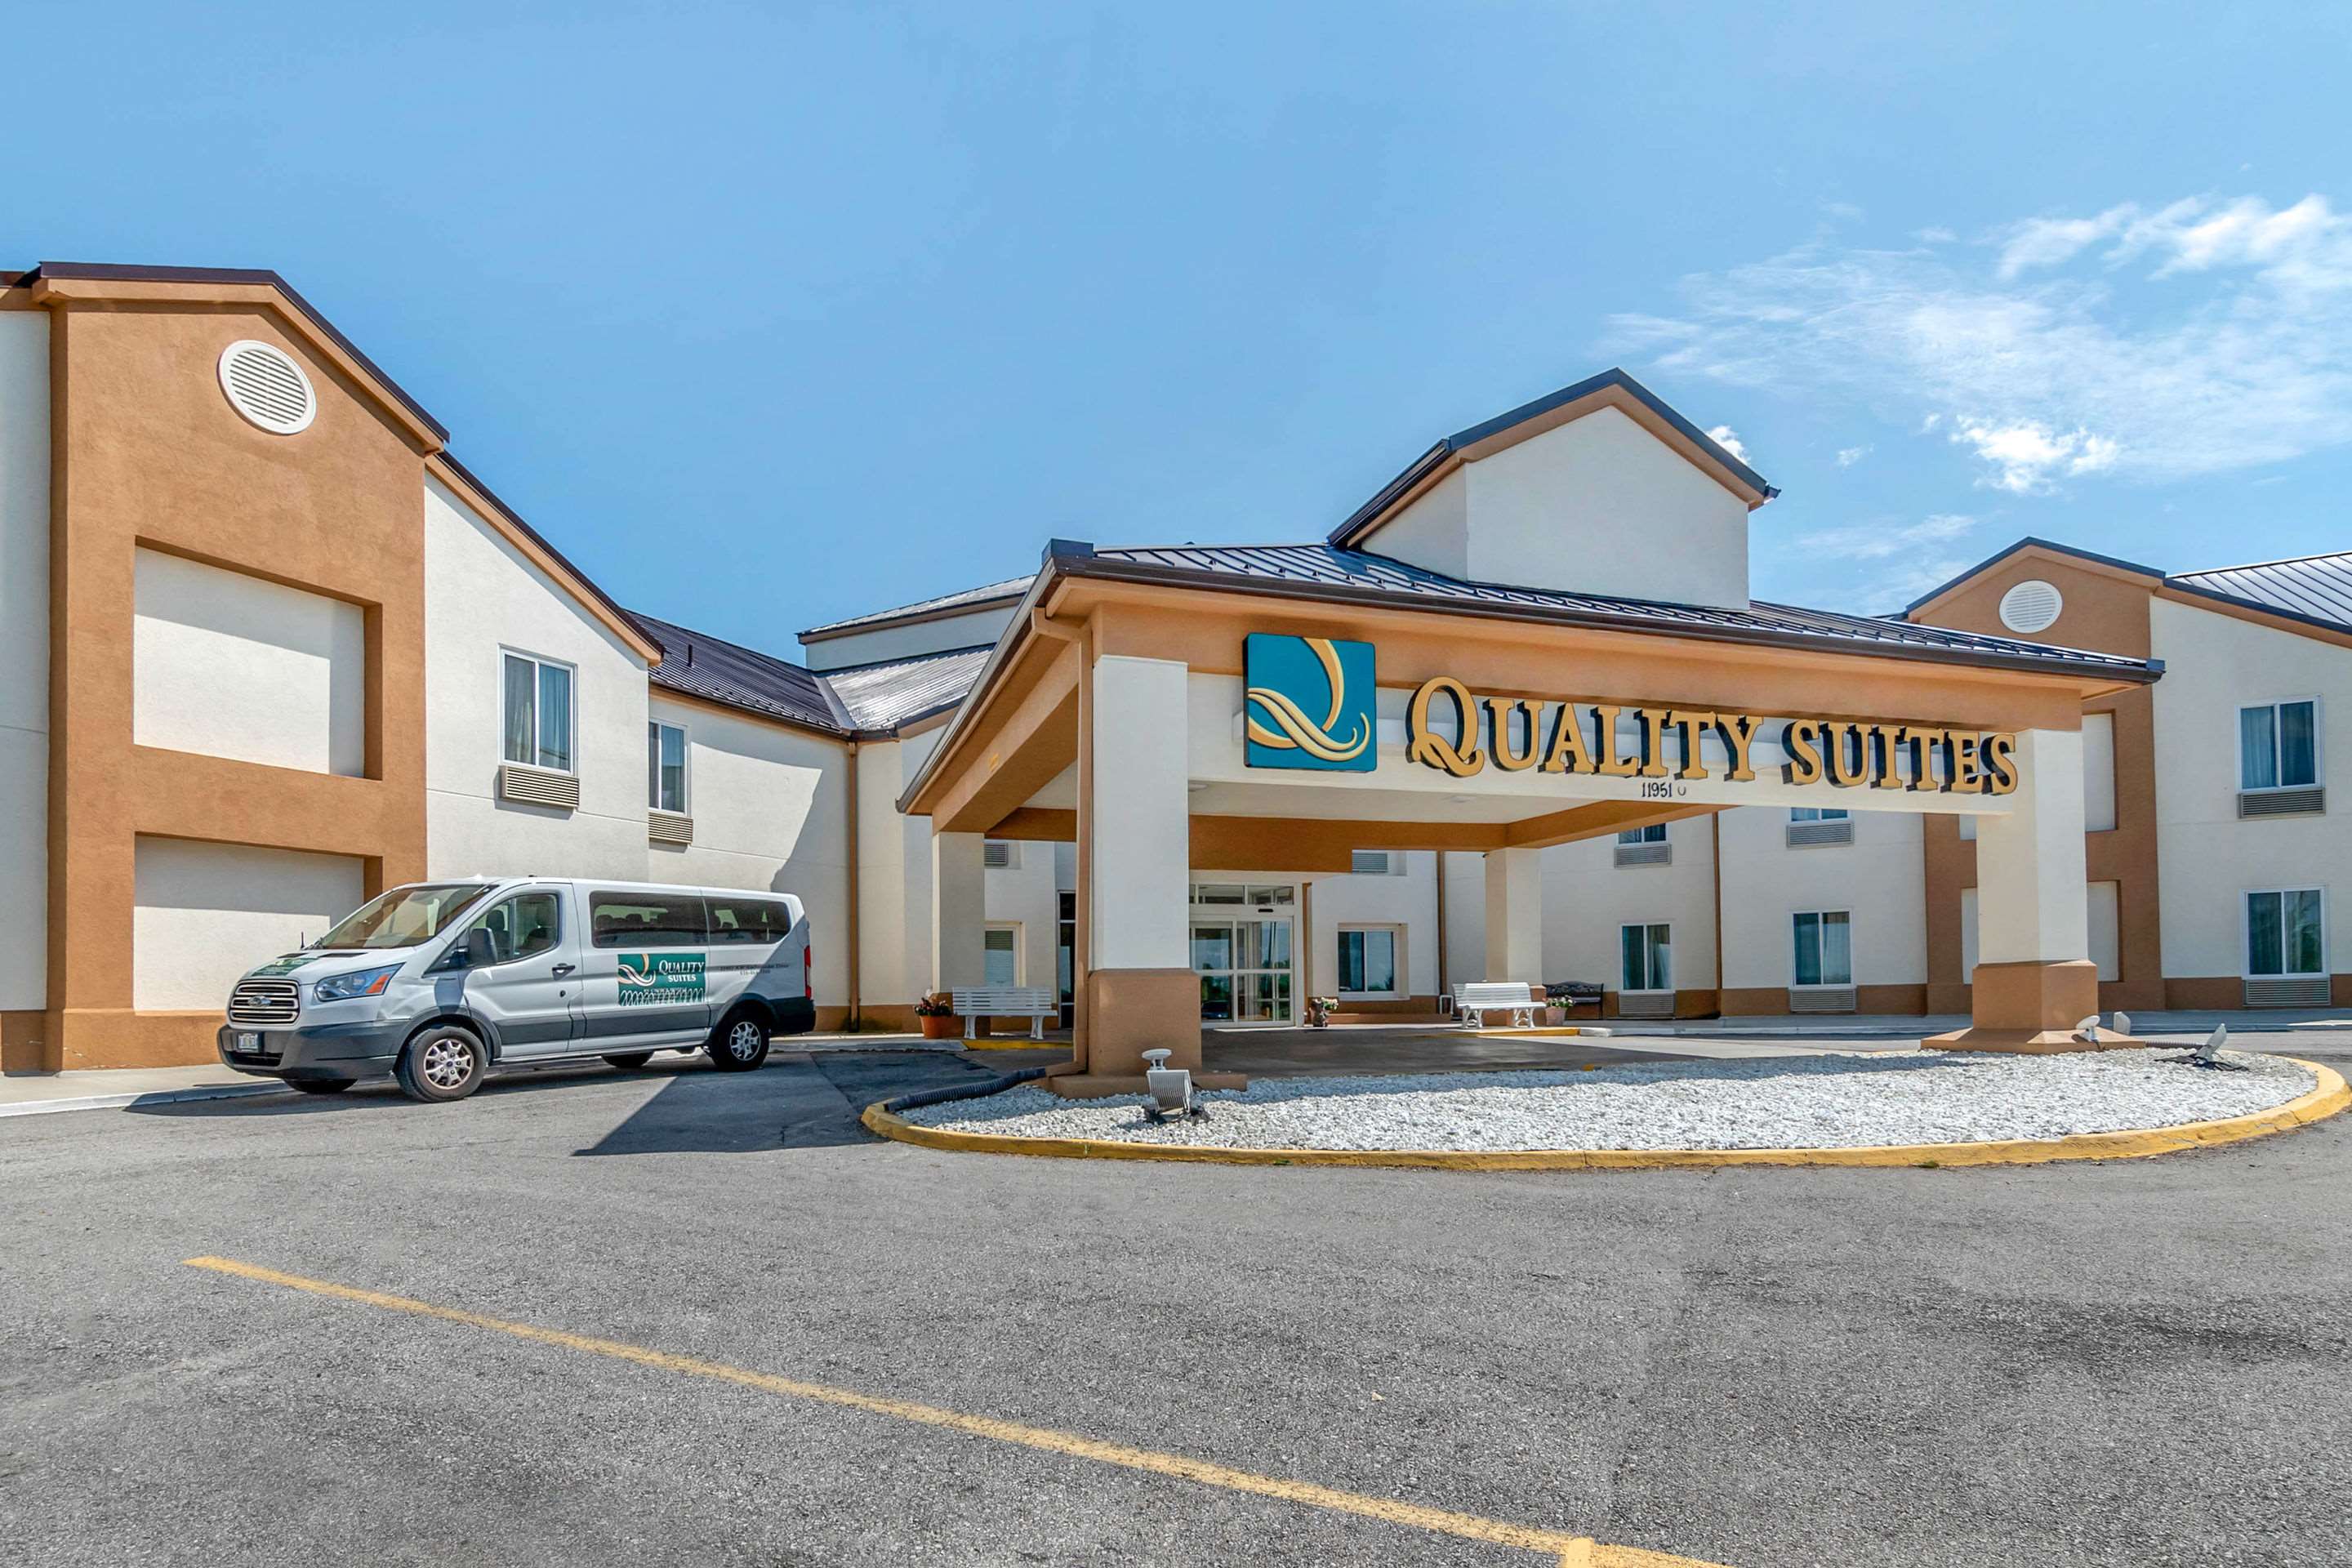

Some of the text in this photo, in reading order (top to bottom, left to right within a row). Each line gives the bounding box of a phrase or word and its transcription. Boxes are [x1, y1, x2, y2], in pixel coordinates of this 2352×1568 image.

[1405, 675, 2018, 795] QUALITY SUITES
[1642, 782, 1673, 798] 11951
[658, 960, 705, 975] QUALITY
[667, 973, 697, 982] SUITES
